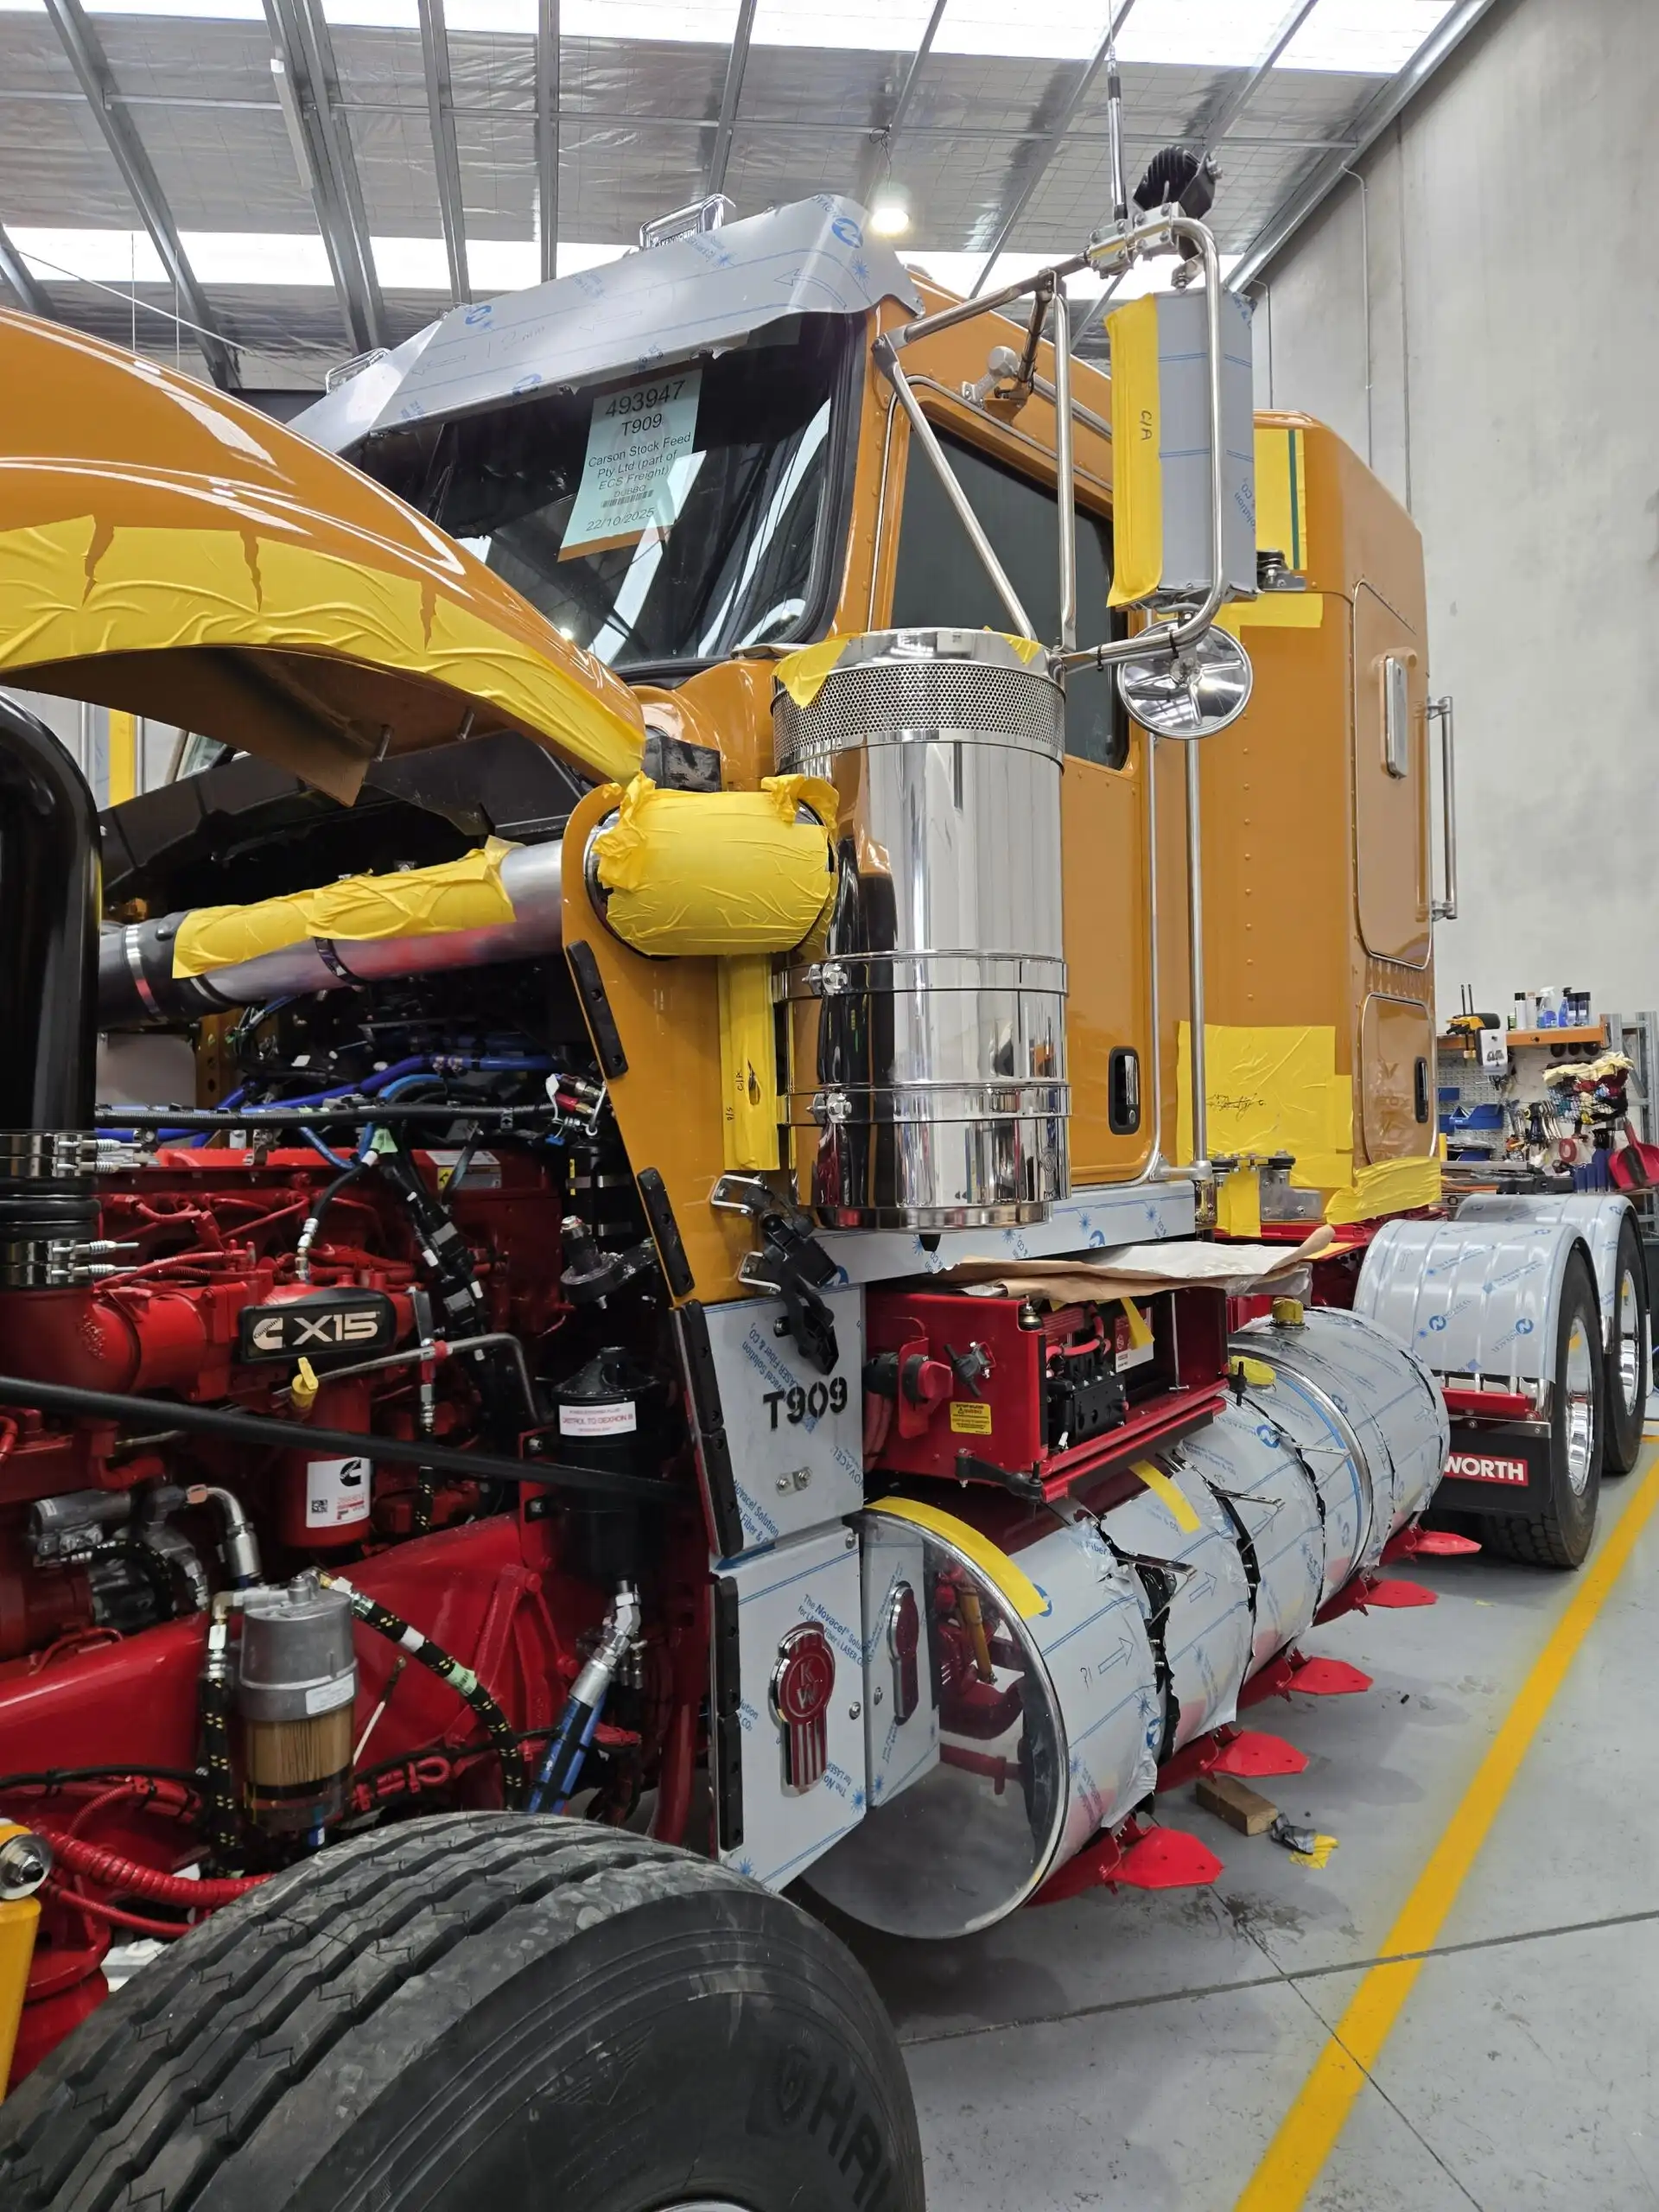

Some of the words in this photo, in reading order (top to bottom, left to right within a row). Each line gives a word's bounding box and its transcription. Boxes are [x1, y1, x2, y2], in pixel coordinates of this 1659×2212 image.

[606, 379, 685, 416] 493947
[622, 413, 662, 436] T909
[588, 451, 626, 467] Carson
[629, 441, 659, 457] Stock
[663, 432, 691, 448] Feed
[597, 468, 615, 479] Pty
[618, 462, 635, 474] Ltd
[638, 454, 663, 471] (part
[665, 449, 677, 461] of
[599, 477, 624, 490] ECS
[626, 467, 670, 484] Freight)
[613, 485, 646, 498] DUBBO
[586, 507, 655, 531] 22/10/2025
[292, 1311, 378, 1346] X15
[762, 1376, 848, 1432] T909
[1444, 1456, 1524, 1481] WORTH
